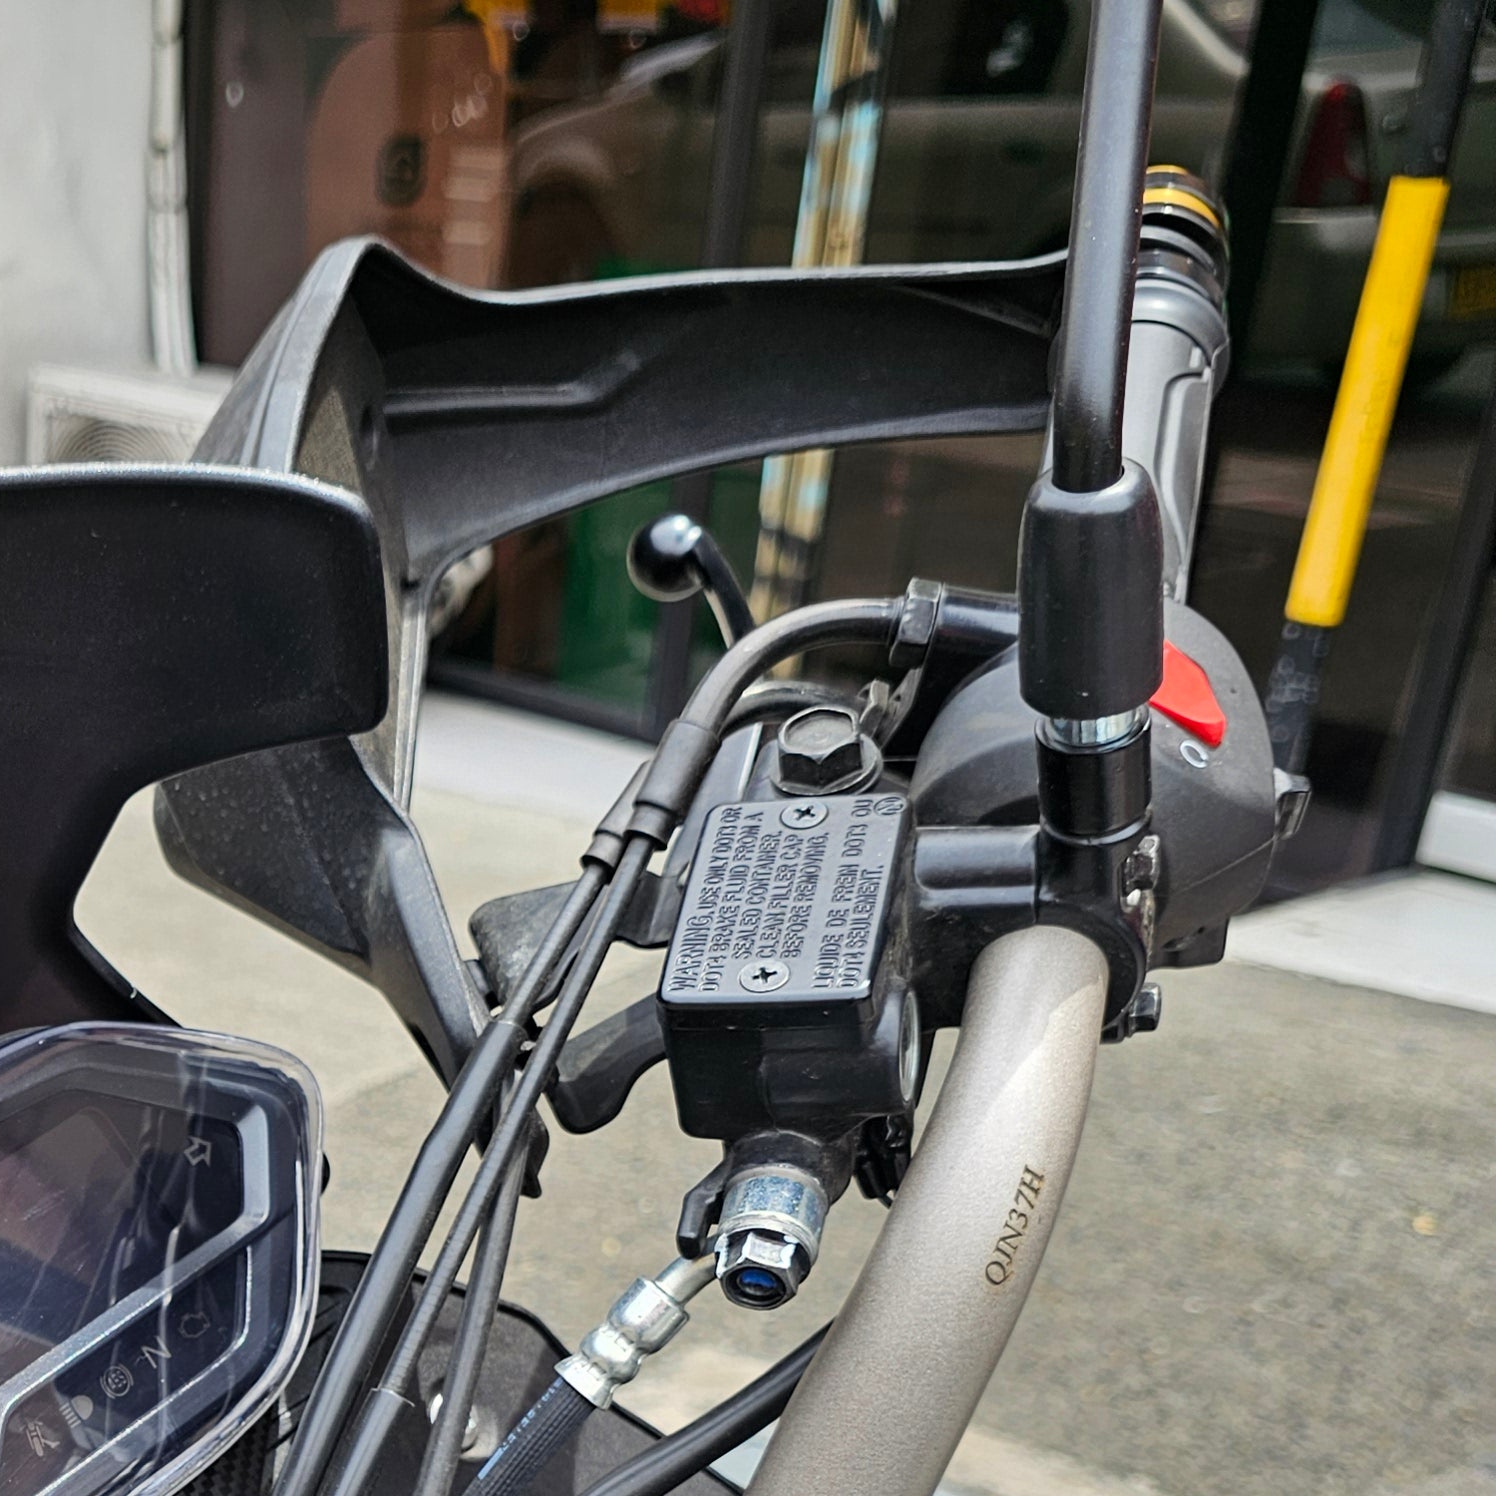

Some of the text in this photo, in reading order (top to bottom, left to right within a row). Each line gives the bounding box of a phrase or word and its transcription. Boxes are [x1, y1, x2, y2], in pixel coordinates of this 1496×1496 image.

[667, 806, 742, 991] WARNING. USE ONLY DOT3 OR
[699, 812, 764, 990] DOT4 BRAKE FLUID FROM A
[732, 831, 783, 958] SEALED CONTAINER.
[757, 833, 804, 957] CLEAN FILLER CAP
[781, 832, 829, 957] BEFORE REMOVING.
[811, 799, 872, 989] LIQUIDE DE FREIN DOT3 OU
[836, 865, 884, 988] DOT4 SEULEMENT.
[985, 1164, 1044, 1286] QJN37H
[141, 1335, 172, 1369] N
